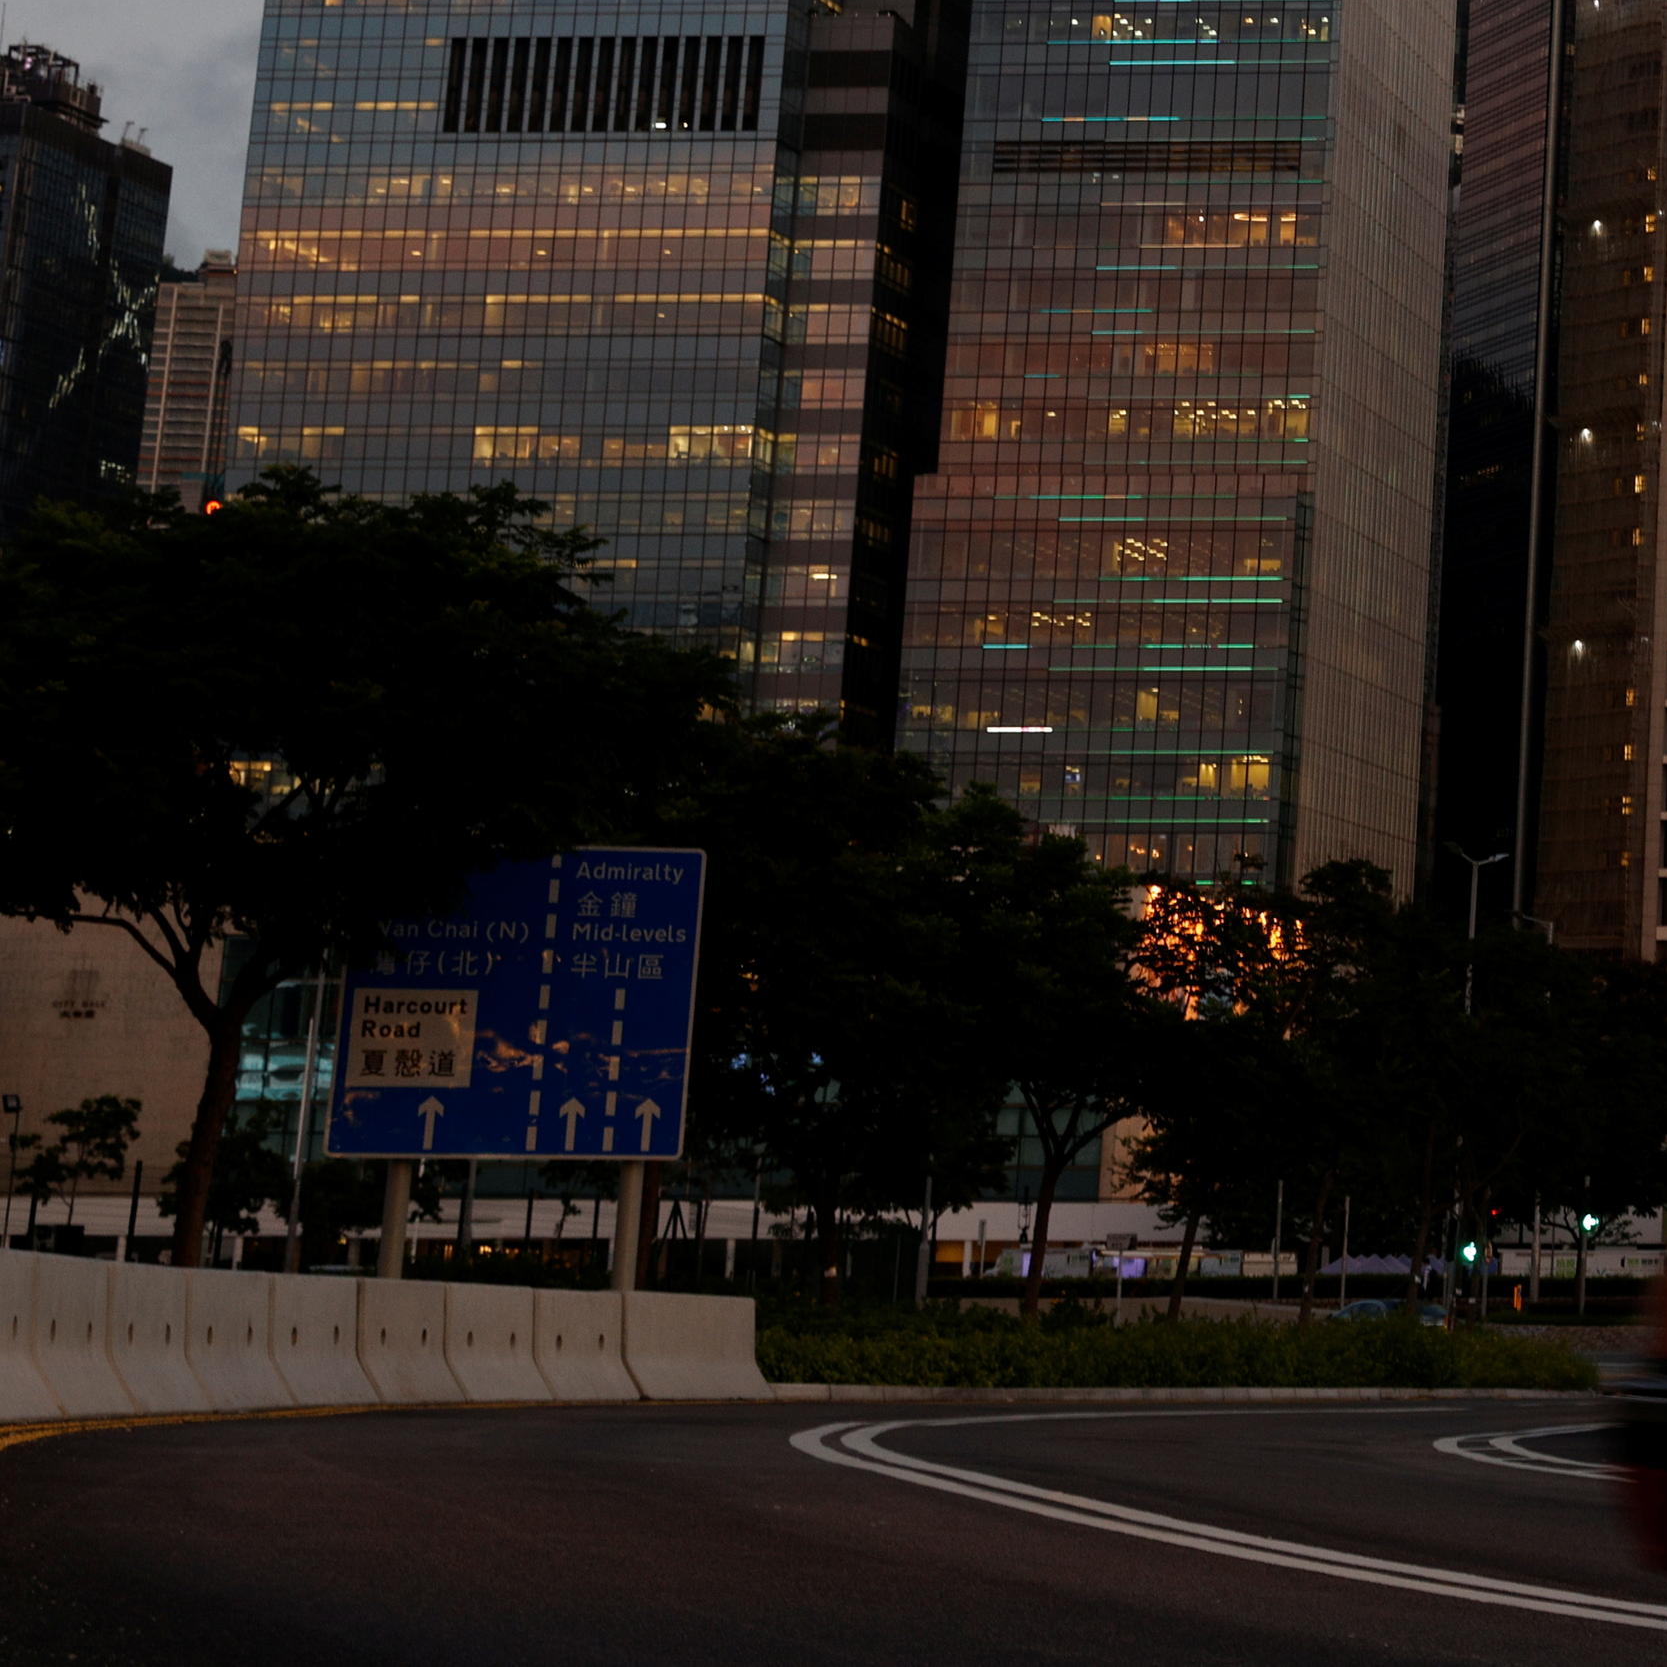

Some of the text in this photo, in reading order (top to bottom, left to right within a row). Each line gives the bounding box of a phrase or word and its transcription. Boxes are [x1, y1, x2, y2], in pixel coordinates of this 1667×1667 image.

[575, 861, 685, 886] Admiralty
[576, 890, 639, 919] 金鐘
[485, 920, 529, 943] (N)
[571, 921, 687, 944] Mid-levels
[570, 952, 665, 981] 半山區
[363, 995, 468, 1016] Harcourt
[361, 1019, 421, 1039] Road
